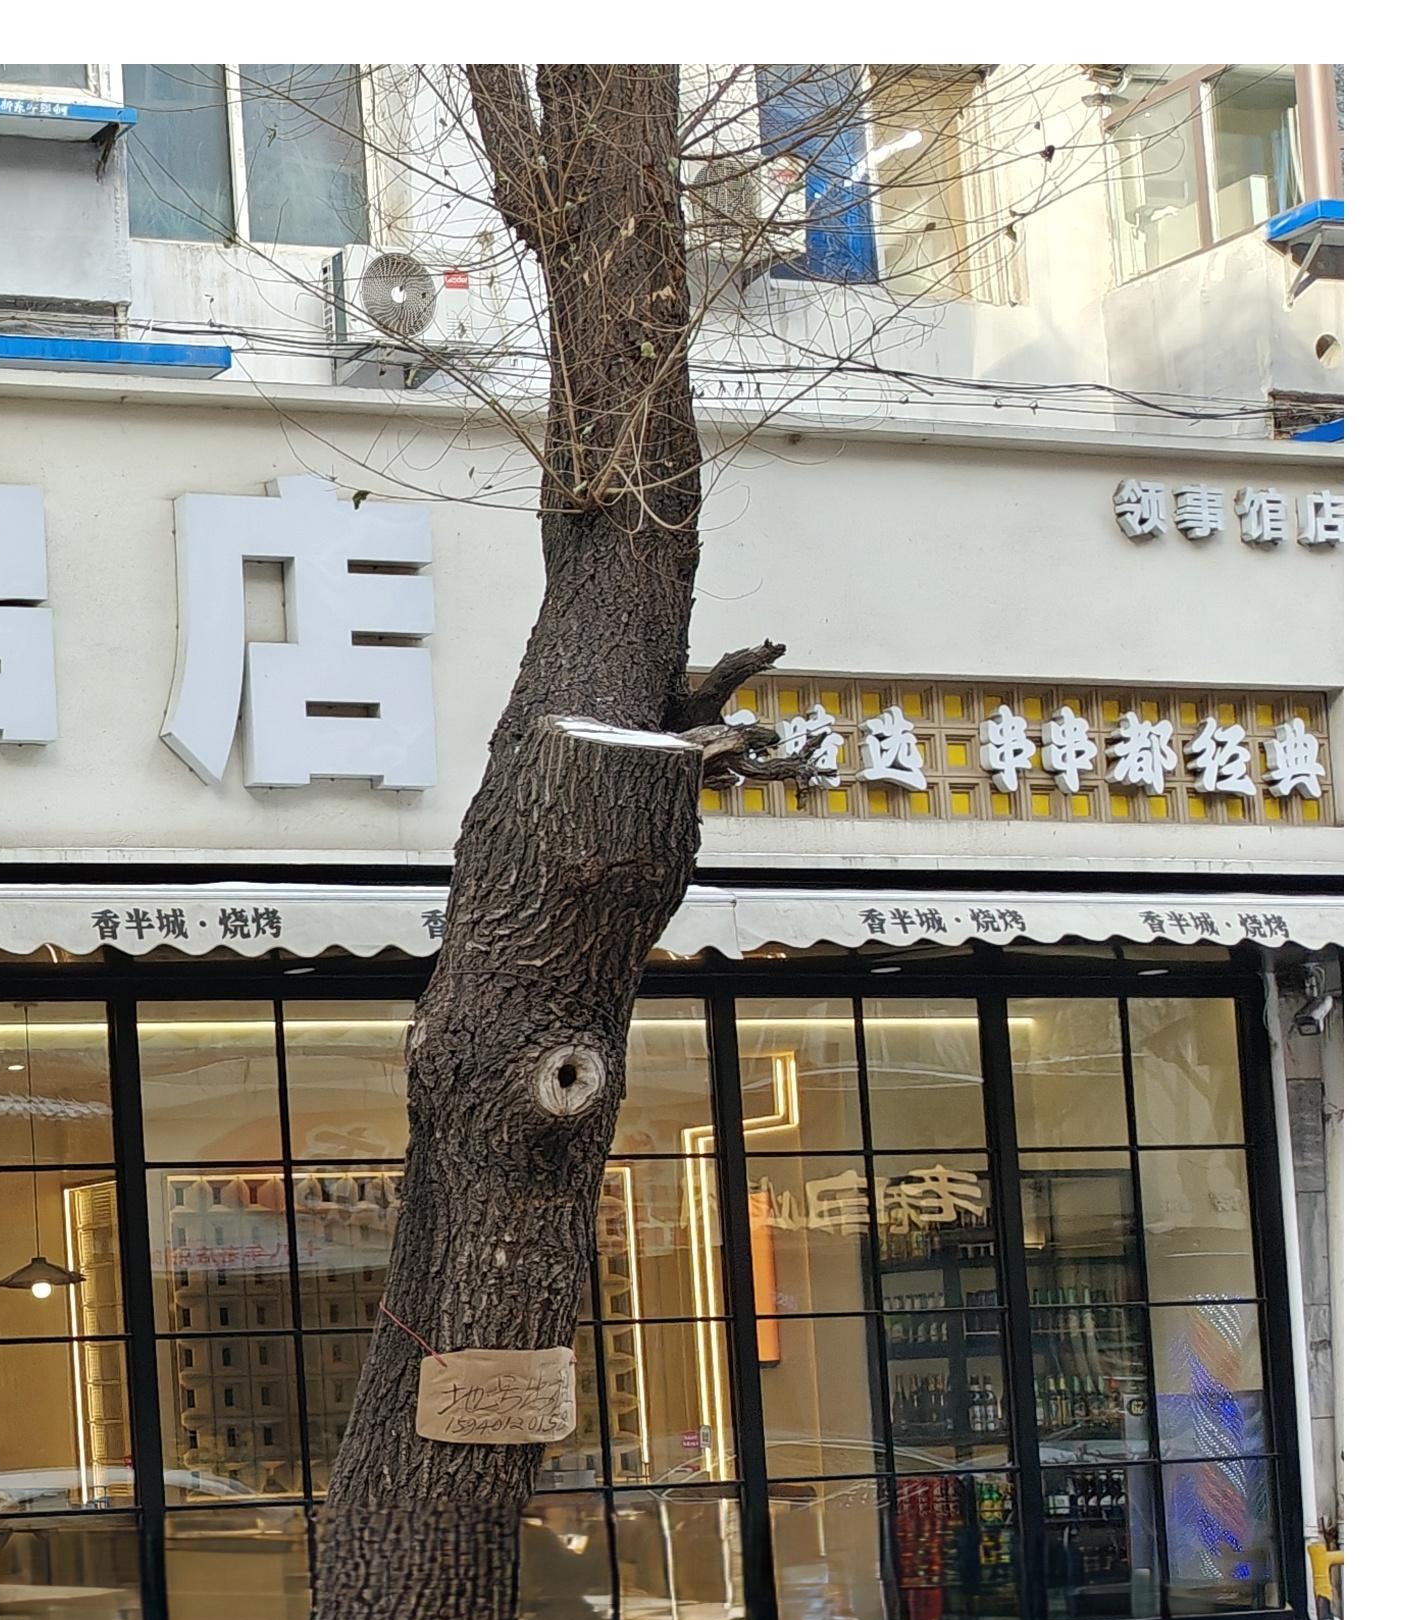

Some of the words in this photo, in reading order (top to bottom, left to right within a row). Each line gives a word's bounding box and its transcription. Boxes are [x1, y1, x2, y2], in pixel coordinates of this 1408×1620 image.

[1113, 478, 1344, 551] 领事馆店
[980, 704, 1326, 799] 串串都经典
[91, 907, 283, 942] 香半城·烧烤
[859, 907, 1028, 936] 香半城·烧烤
[1139, 910, 1292, 940] 香半城·烧烤
